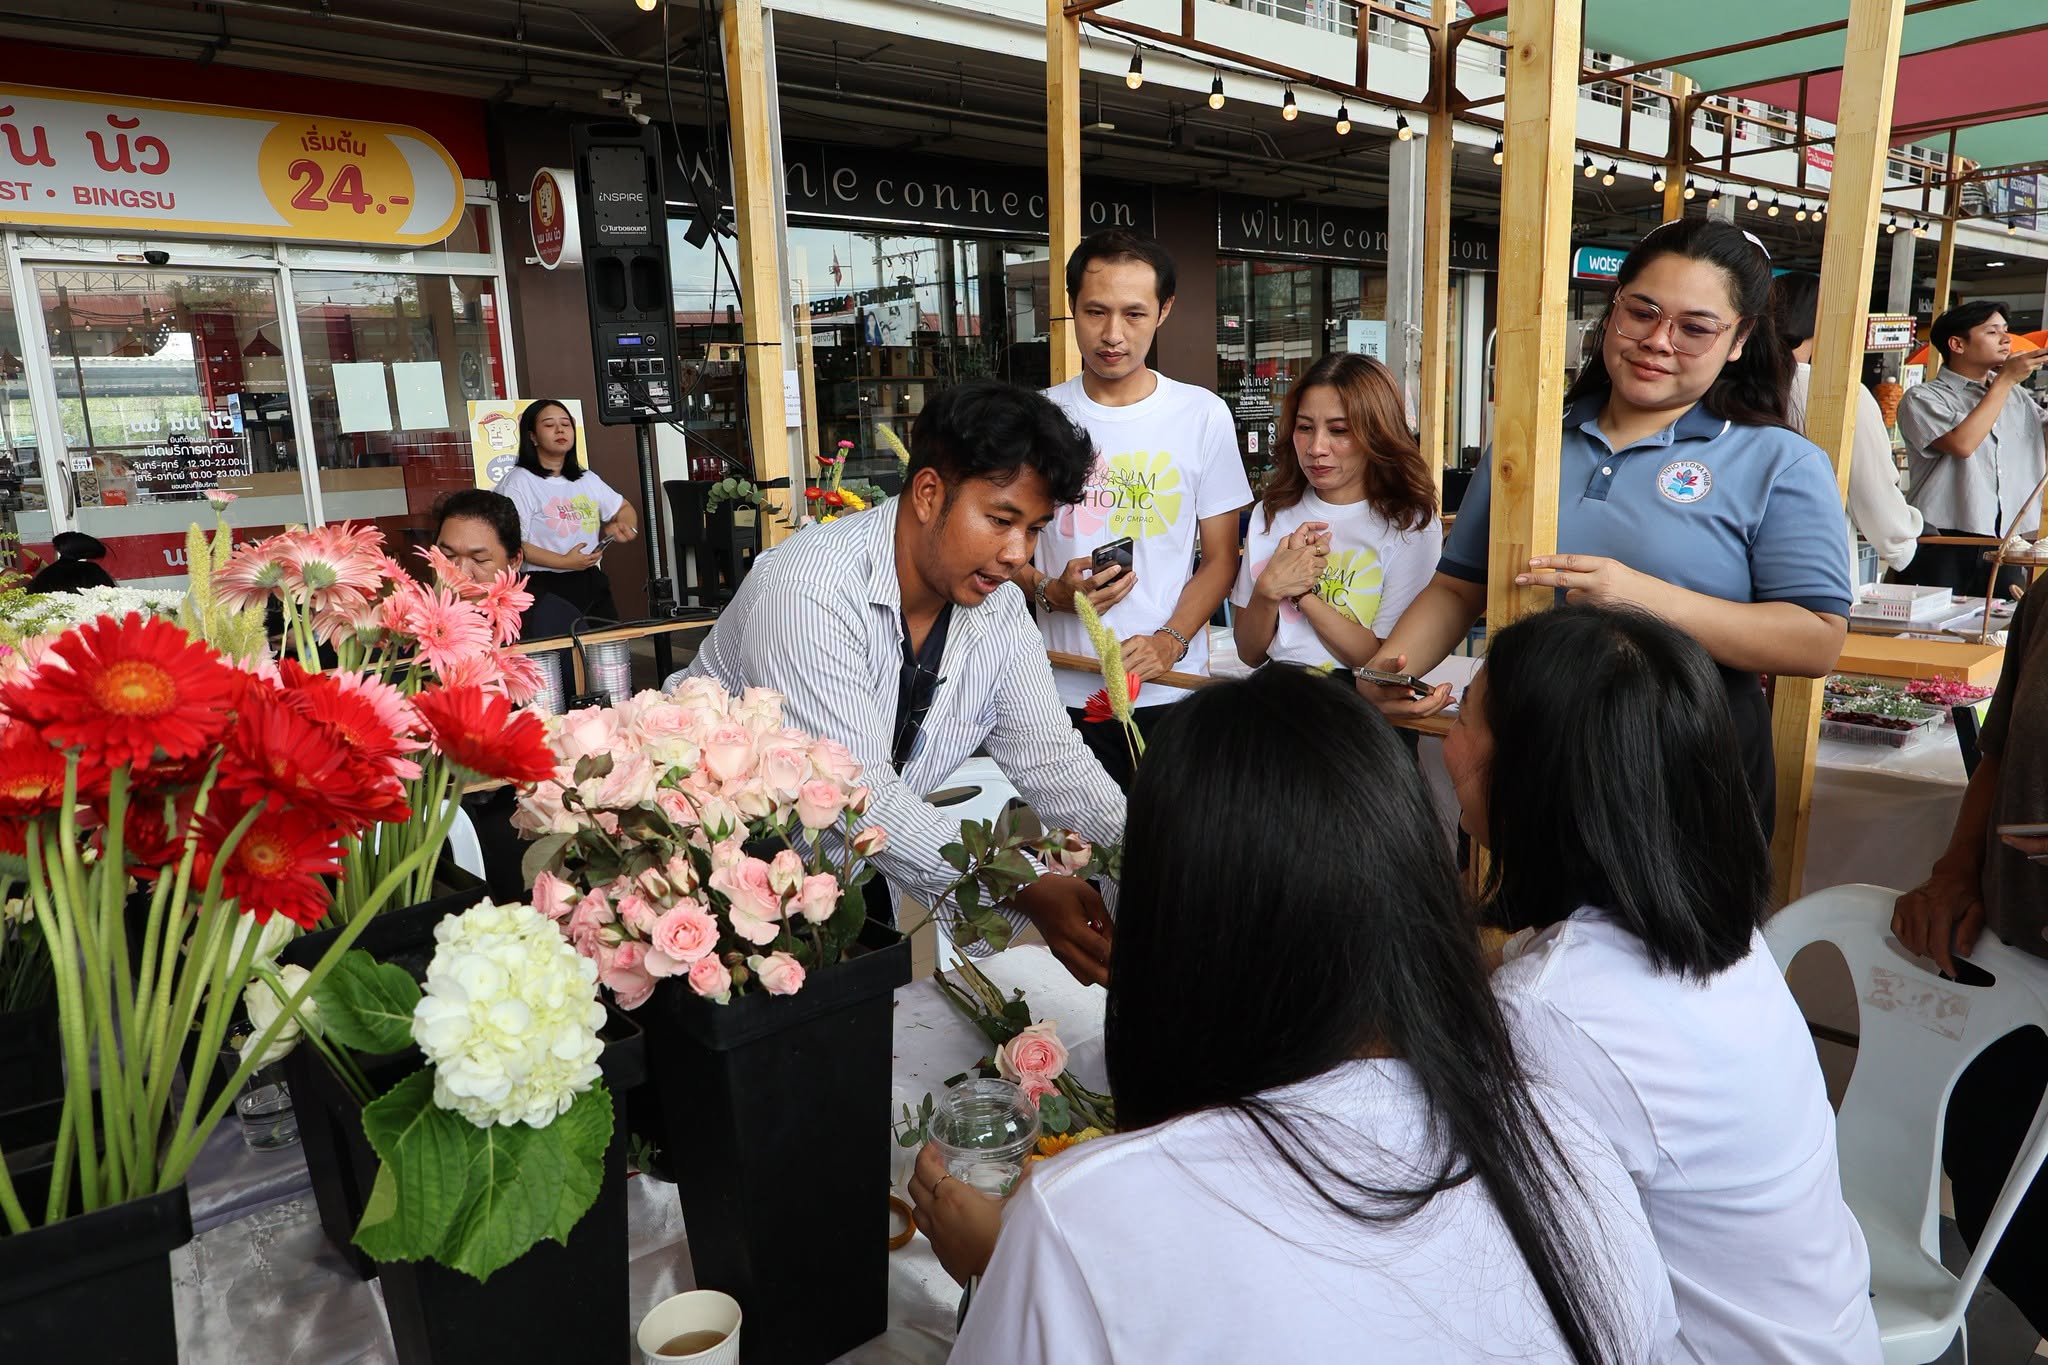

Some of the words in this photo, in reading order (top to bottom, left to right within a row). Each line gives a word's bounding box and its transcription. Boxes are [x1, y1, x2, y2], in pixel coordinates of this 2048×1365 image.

[86, 113, 171, 175] นัว
[301, 124, 367, 157] เริ่มต้น
[73, 185, 177, 210] BINGSU
[288, 158, 410, 214] 24.-
[875, 178, 1136, 227] connecon
[1241, 201, 1336, 247] wine
[1589, 255, 1624, 273] wats
[1239, 373, 1270, 387] wine
[209, 410, 235, 430] นัว
[144, 443, 235, 458] เปิดบริการทุกวัน
